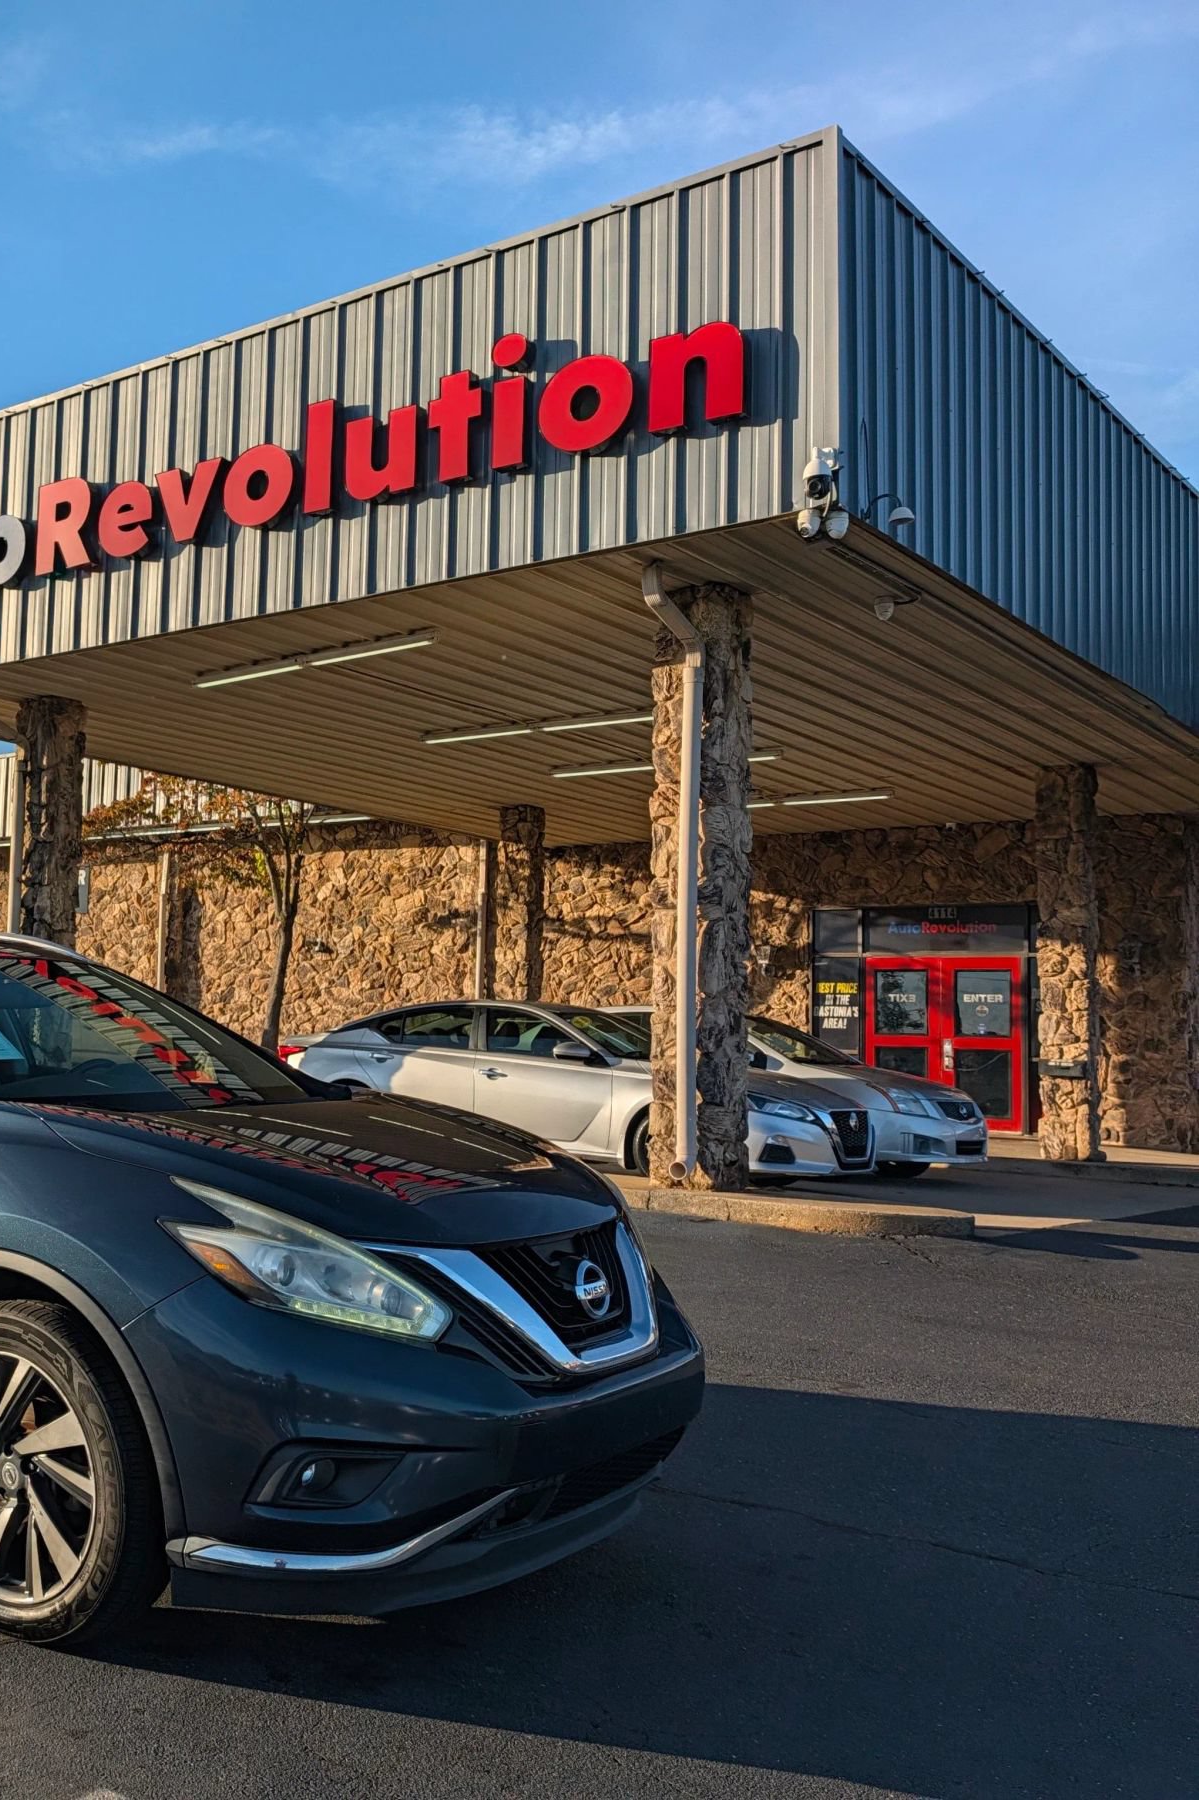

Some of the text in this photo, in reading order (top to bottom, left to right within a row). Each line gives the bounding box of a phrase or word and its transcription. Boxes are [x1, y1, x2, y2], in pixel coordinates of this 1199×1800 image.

[836, 982, 858, 993] PRICE
[836, 994, 850, 1005] THE
[963, 994, 1003, 1003] ENTER
[822, 1018, 847, 1029] AREA!
[583, 1283, 606, 1297] NISS
